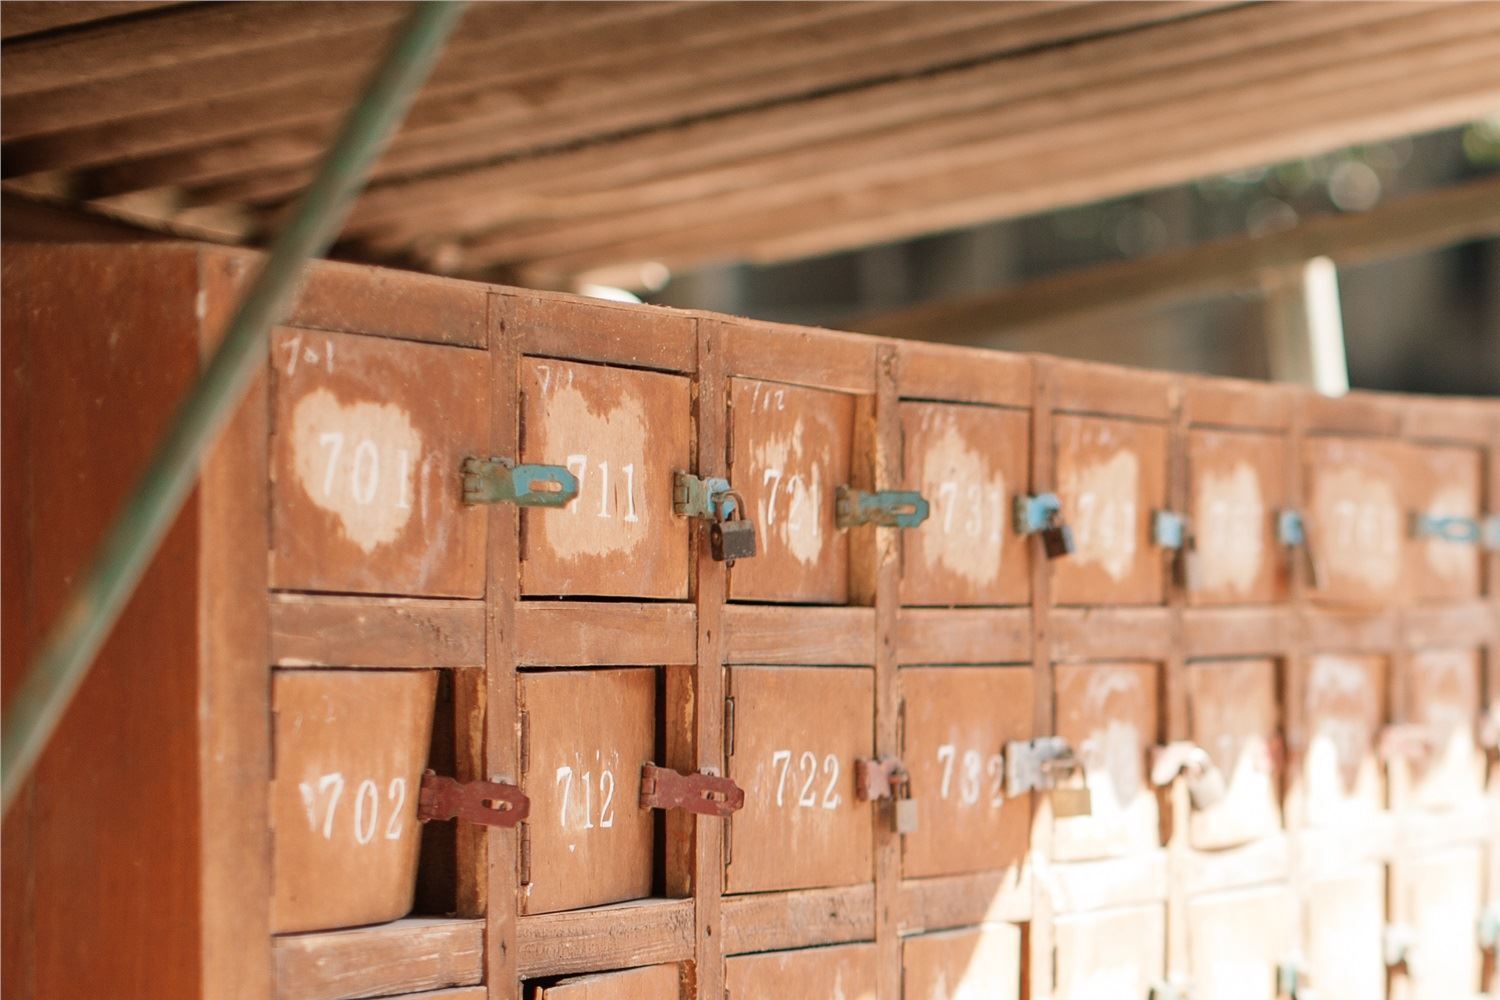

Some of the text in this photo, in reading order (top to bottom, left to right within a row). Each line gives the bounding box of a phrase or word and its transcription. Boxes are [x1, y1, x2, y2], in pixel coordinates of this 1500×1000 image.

[319, 431, 409, 510] 701
[566, 454, 639, 522] 711
[319, 771, 406, 845] 702
[556, 766, 615, 829] 712
[772, 750, 840, 810] 722
